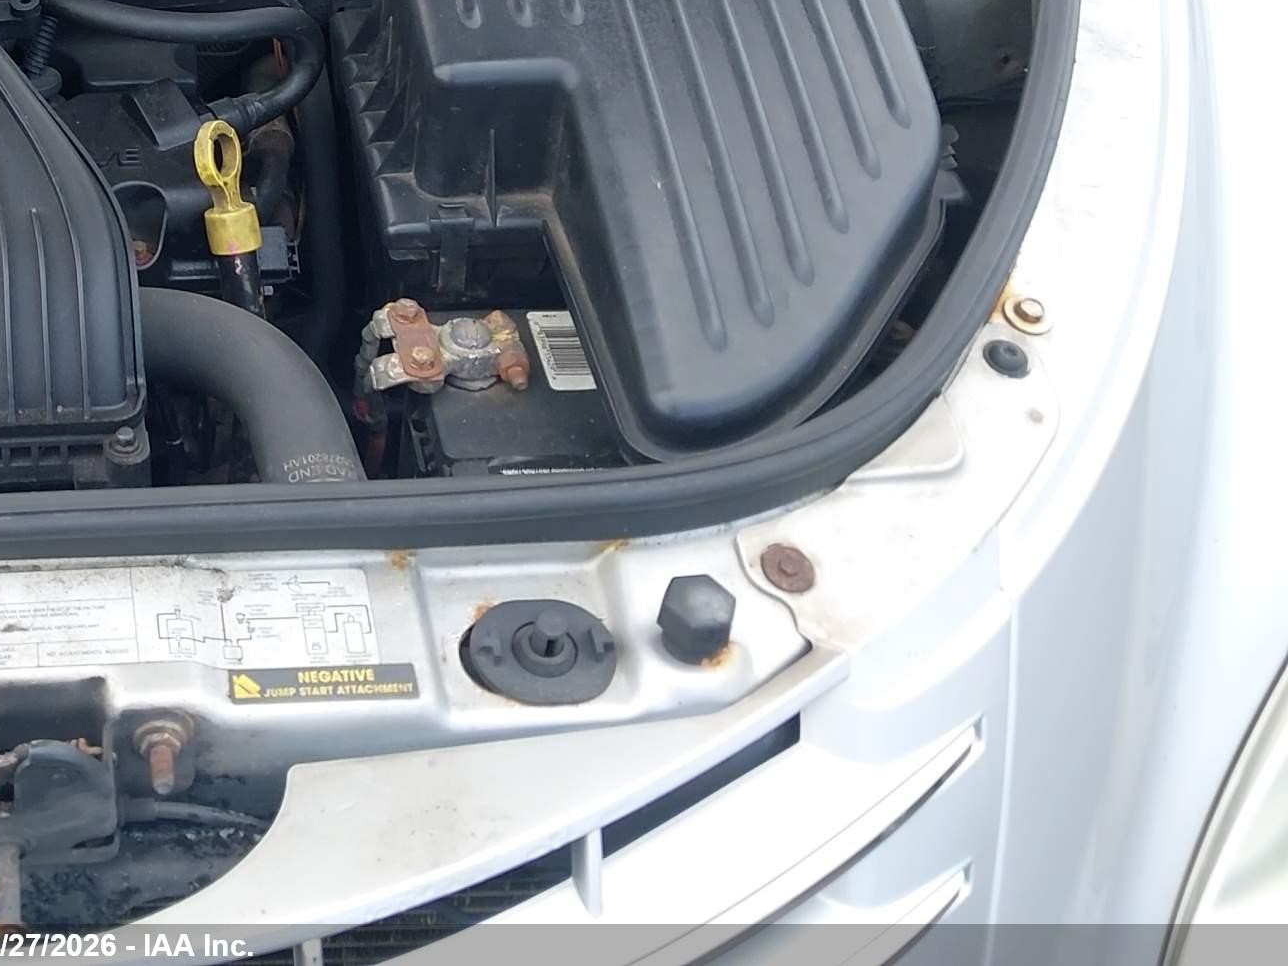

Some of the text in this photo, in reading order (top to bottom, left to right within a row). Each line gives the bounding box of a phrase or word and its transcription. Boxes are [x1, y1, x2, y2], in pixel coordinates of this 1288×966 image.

[297, 668, 375, 684] NEGATIVE
[263, 682, 413, 698] JUMP START ATTACHMENT
